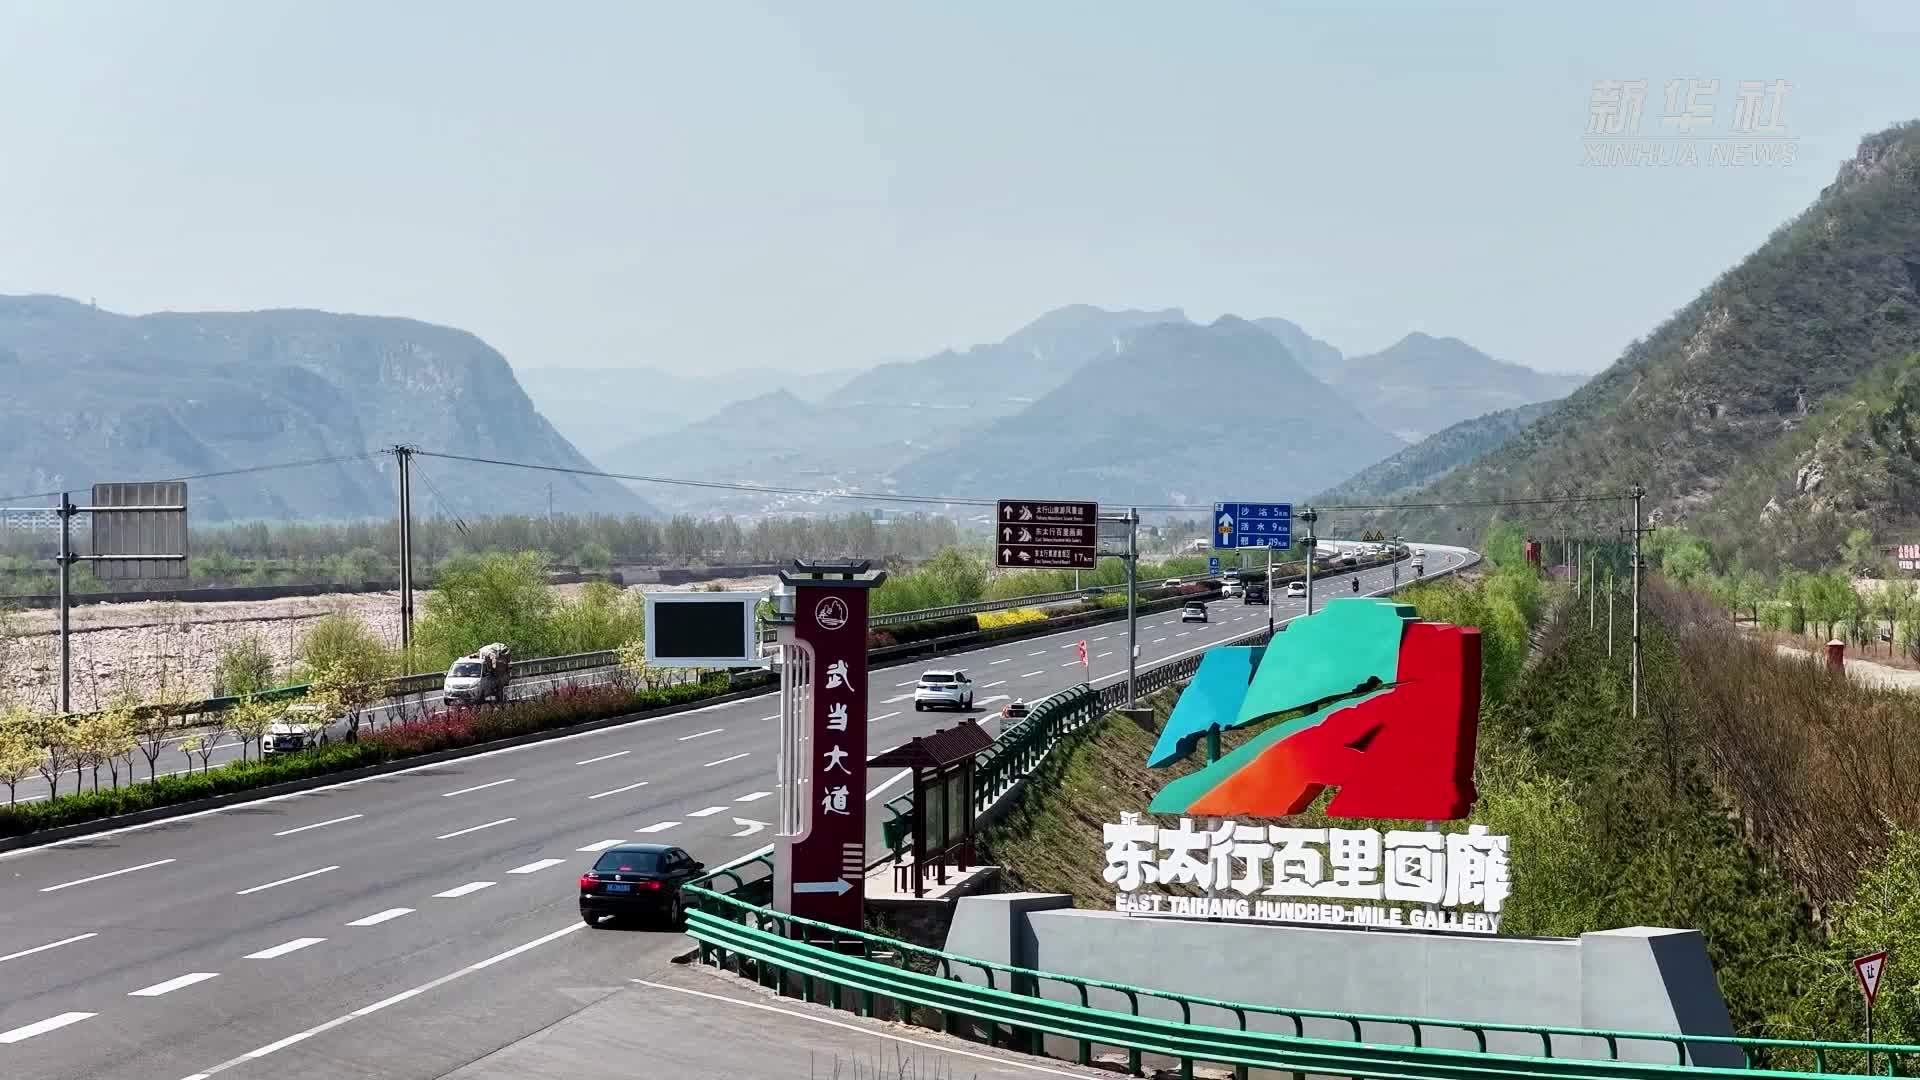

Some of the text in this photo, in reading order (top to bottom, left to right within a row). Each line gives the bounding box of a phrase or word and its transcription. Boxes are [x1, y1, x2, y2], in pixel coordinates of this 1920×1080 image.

[822, 659, 855, 815] 武当大道
[1103, 811, 1513, 912] 东太行百里画廊
[1115, 893, 1502, 934] EAST TAIHANG HUNDRED-MILE GALLERY
[1866, 964, 1875, 979] 让
